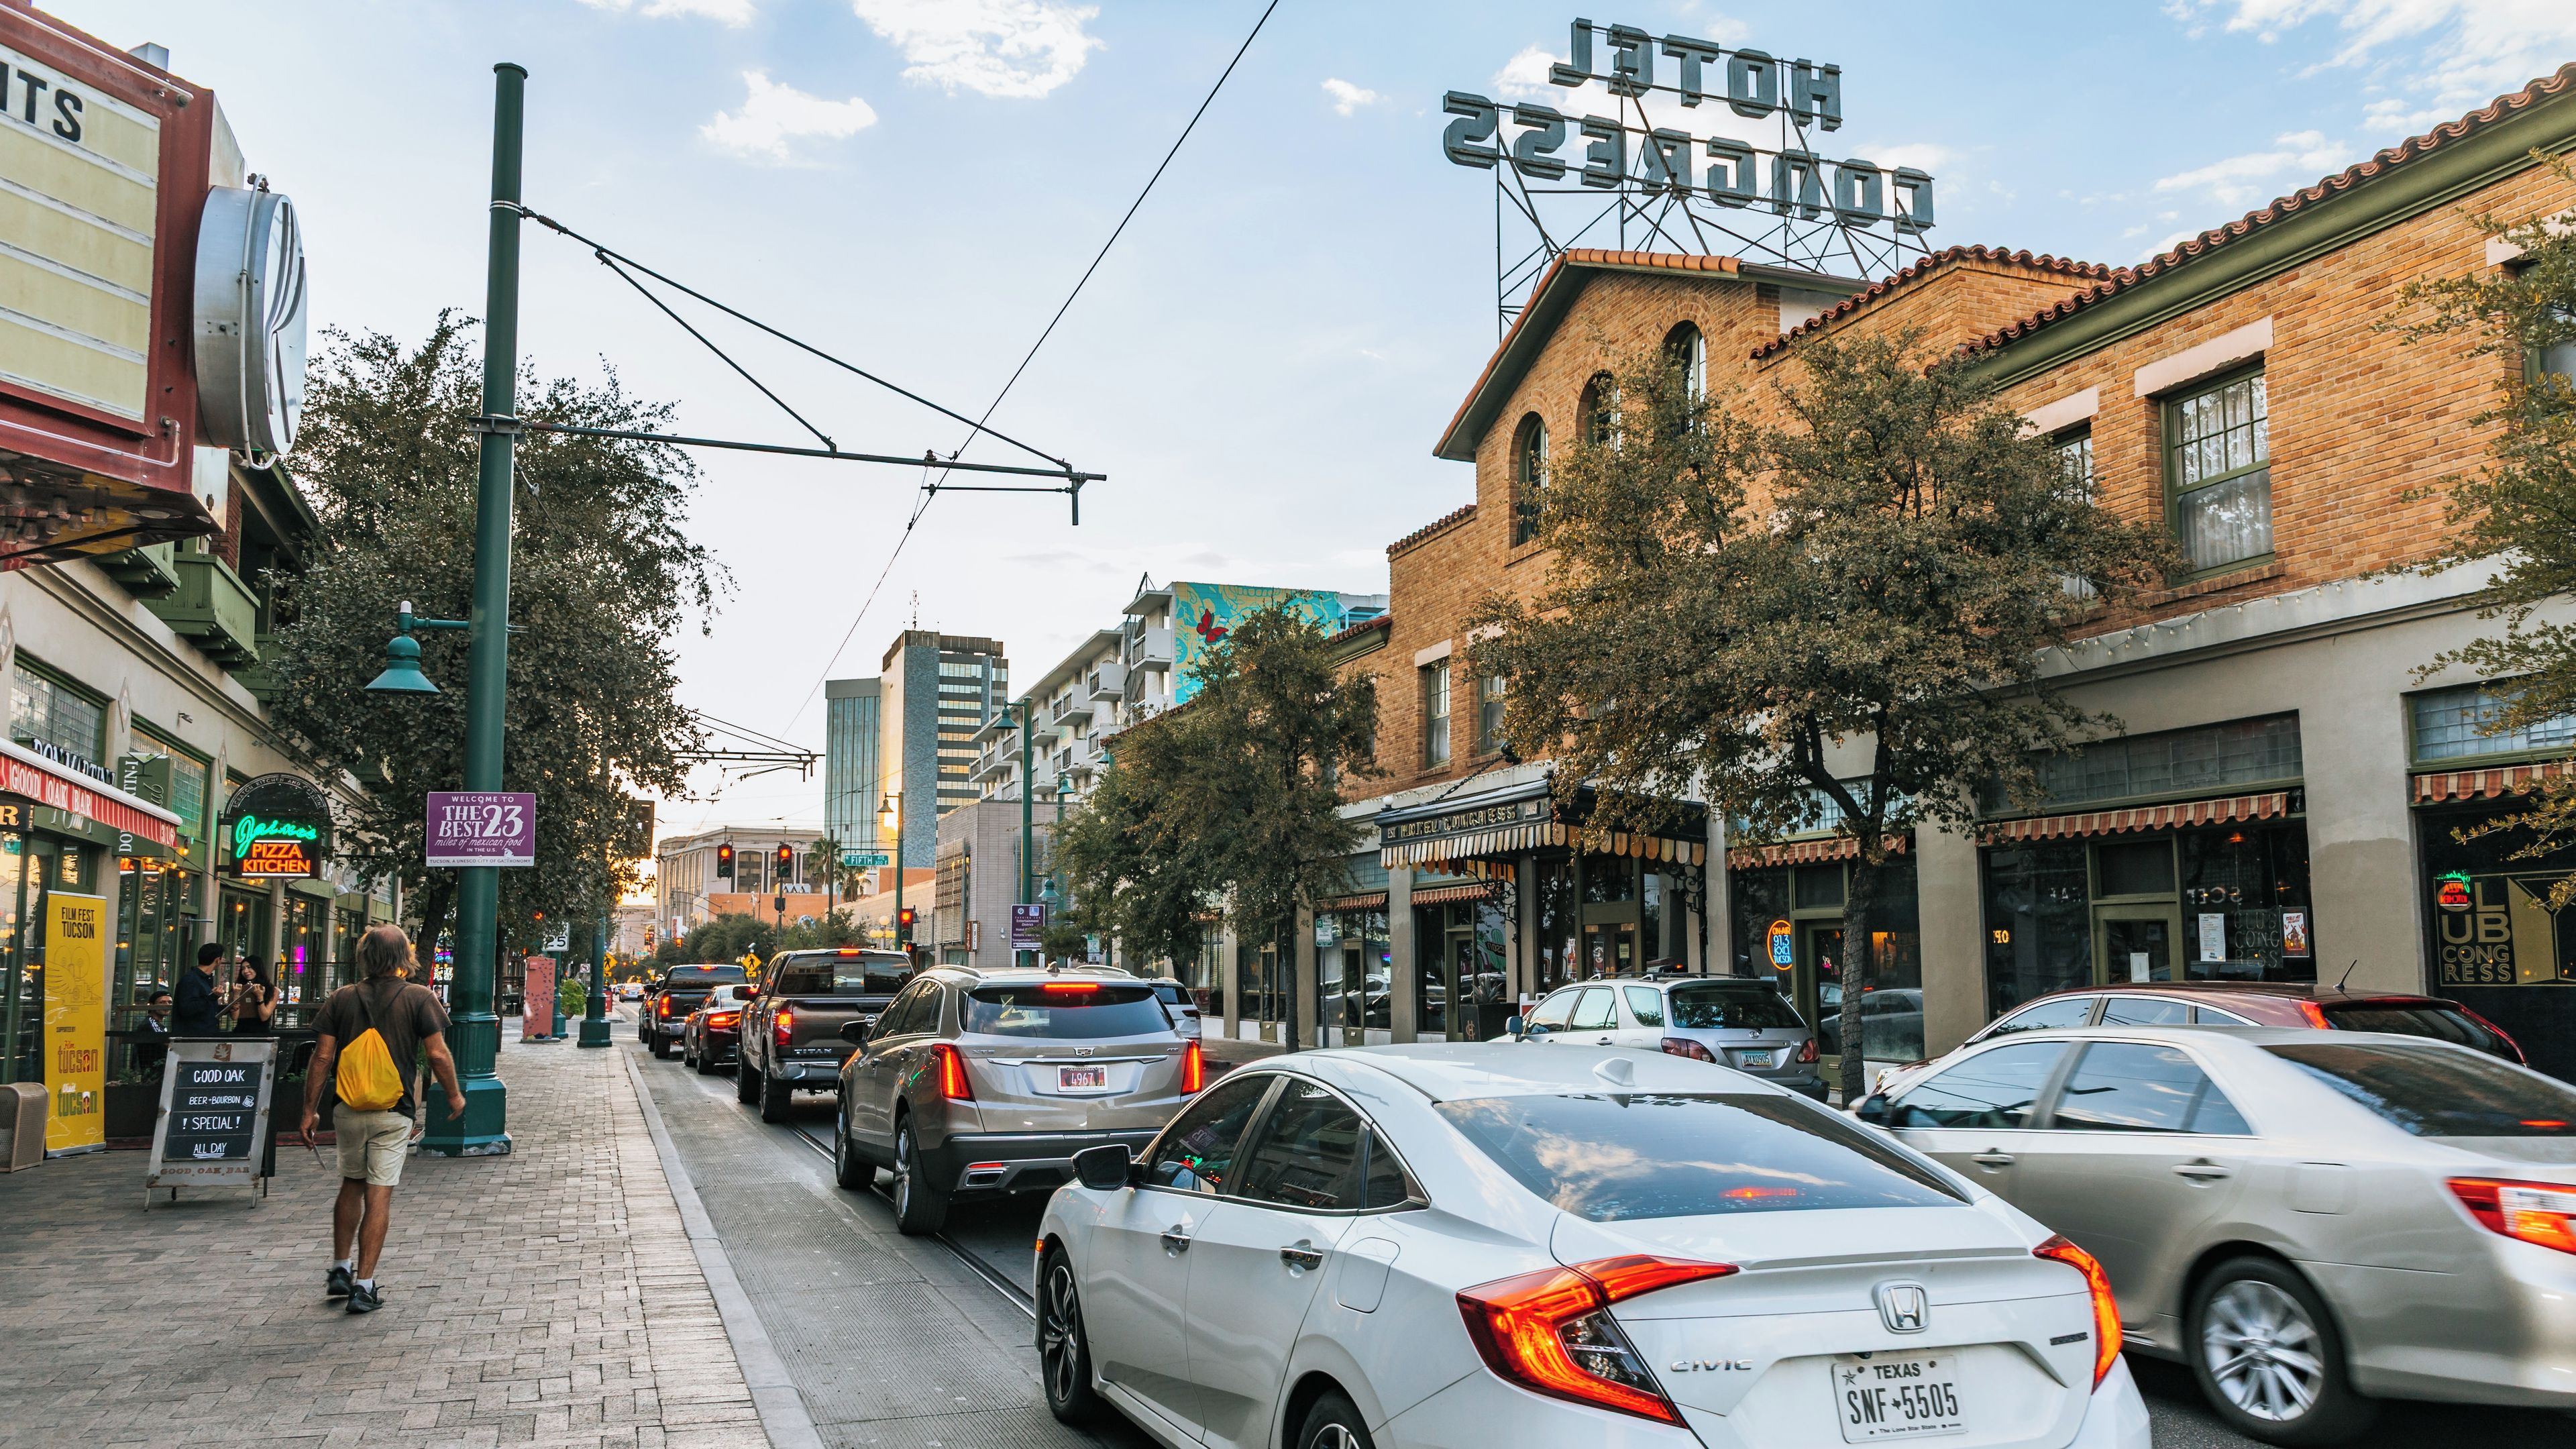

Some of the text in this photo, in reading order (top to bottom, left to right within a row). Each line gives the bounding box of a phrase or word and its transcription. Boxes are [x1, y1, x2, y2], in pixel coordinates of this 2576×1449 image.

[11, 764, 92, 816] GOOD OAK BAR
[442, 804, 524, 837] THE 23
[1401, 820, 1438, 838] HOTEL
[1444, 804, 1516, 831] CONGRESS
[1525, 803, 1538, 816] 1919
[438, 820, 484, 838] BEST
[435, 836, 526, 850] miles of mexican food
[252, 843, 303, 859] PIZZA
[242, 859, 311, 873] KITCHEN
[851, 856, 873, 865] FIFTH
[62, 907, 95, 922] FILM FEST
[62, 921, 95, 939] TUCSON
[546, 934, 566, 947] 25
[1773, 934, 1790, 947] 91.3
[2442, 945, 2510, 964] CONG
[2444, 963, 2512, 982] RESS
[194, 1069, 246, 1083] GOOD OAK
[1071, 1073, 1094, 1085] 4967
[193, 1116, 233, 1130] SPECIAL
[193, 1142, 227, 1154] ALL DAY
[1670, 1358, 1754, 1373] CIVIC
[1872, 1362, 1921, 1381] TEXAS
